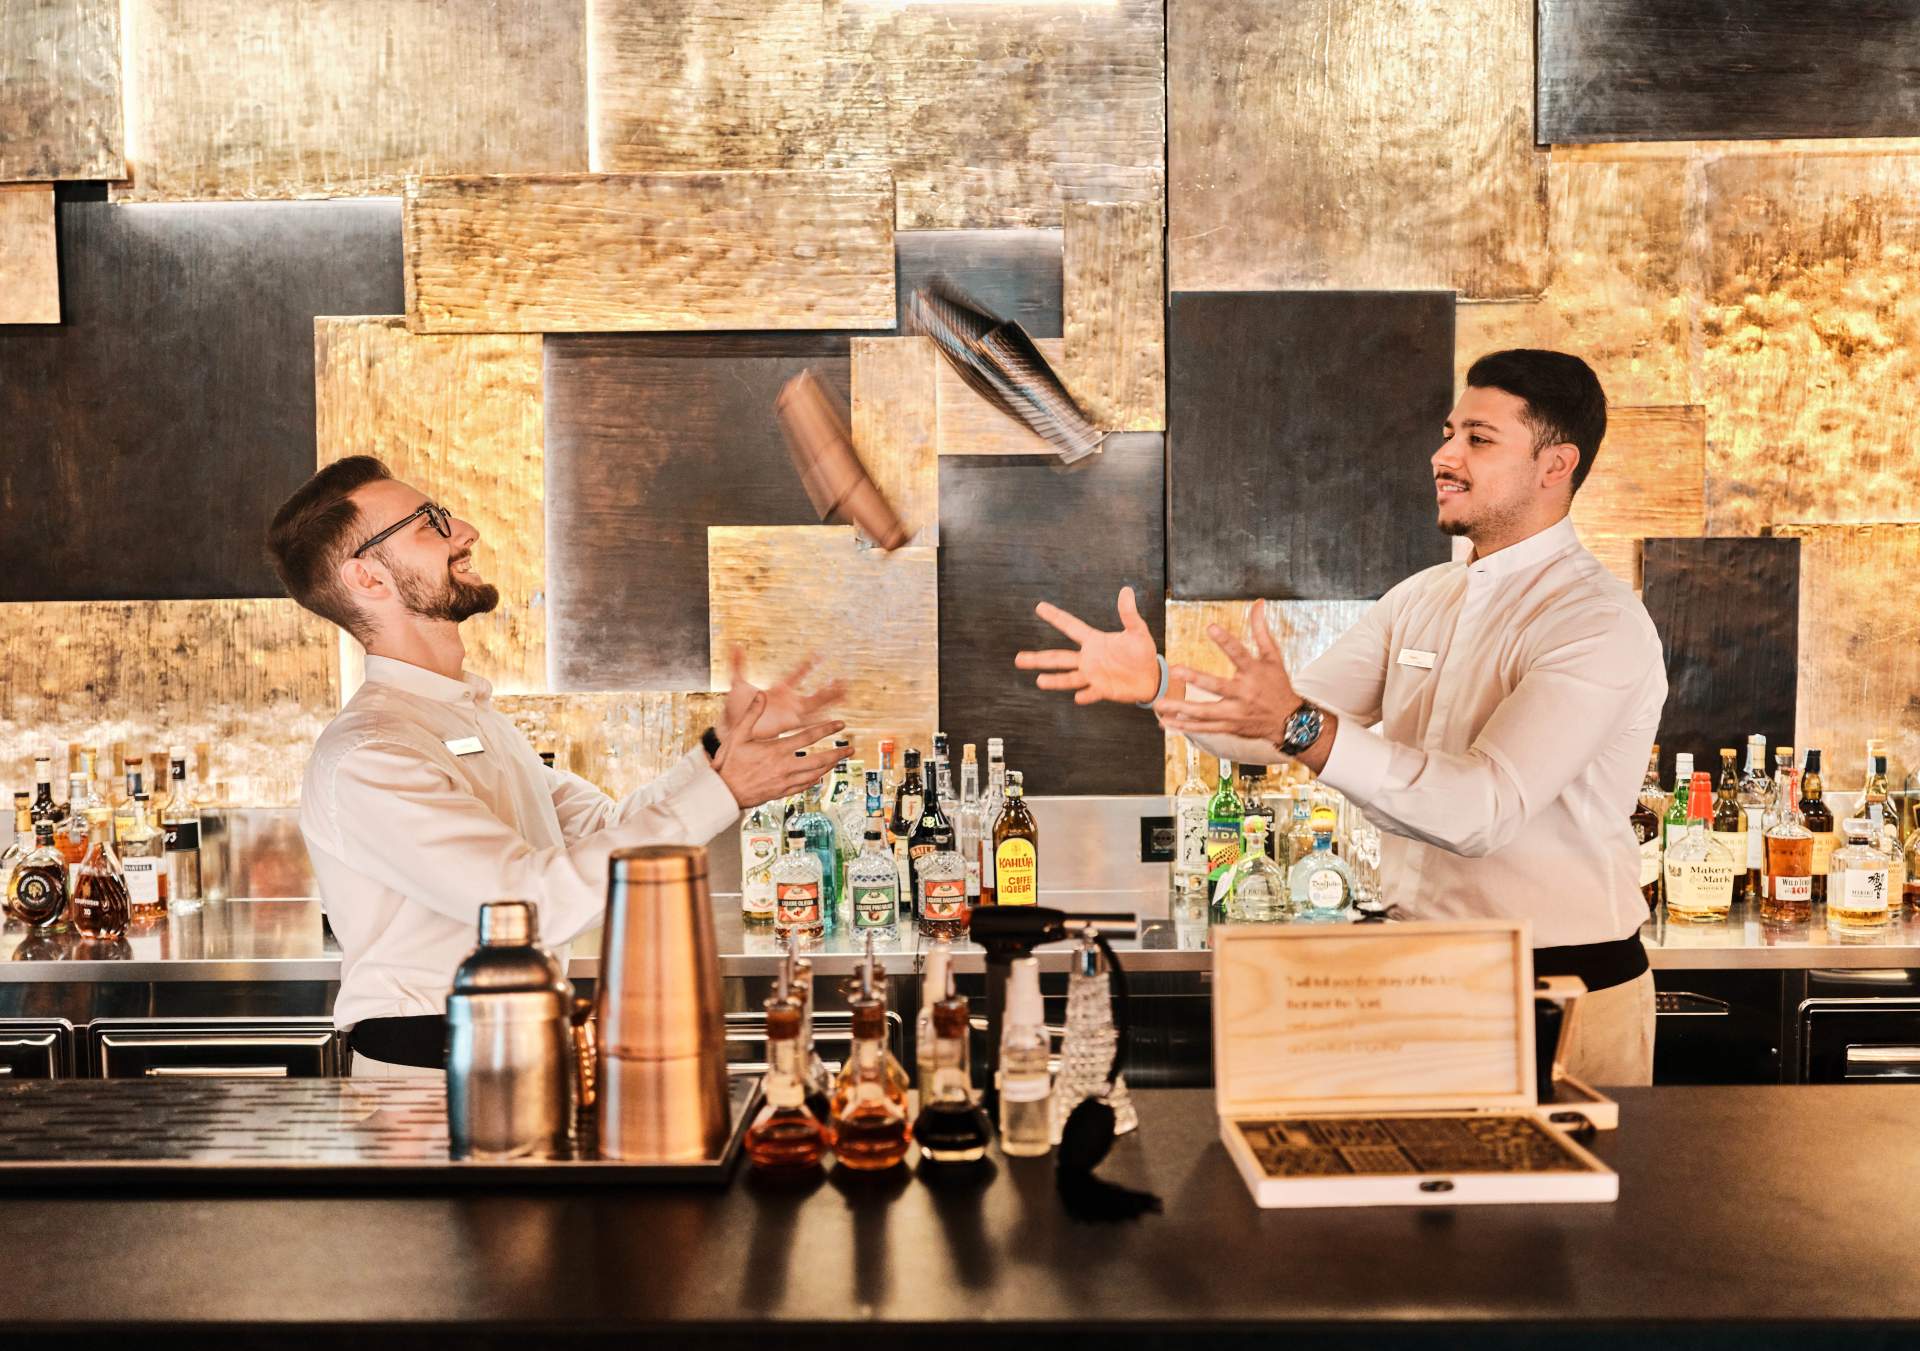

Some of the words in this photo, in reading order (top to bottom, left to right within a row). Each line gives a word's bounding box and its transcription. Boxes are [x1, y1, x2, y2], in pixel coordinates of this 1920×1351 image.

[1208, 832, 1239, 840] VIDA
[999, 853, 1033, 868] KAHLÚA
[1690, 866, 1733, 874] Maker's
[1703, 875, 1730, 884] Mark
